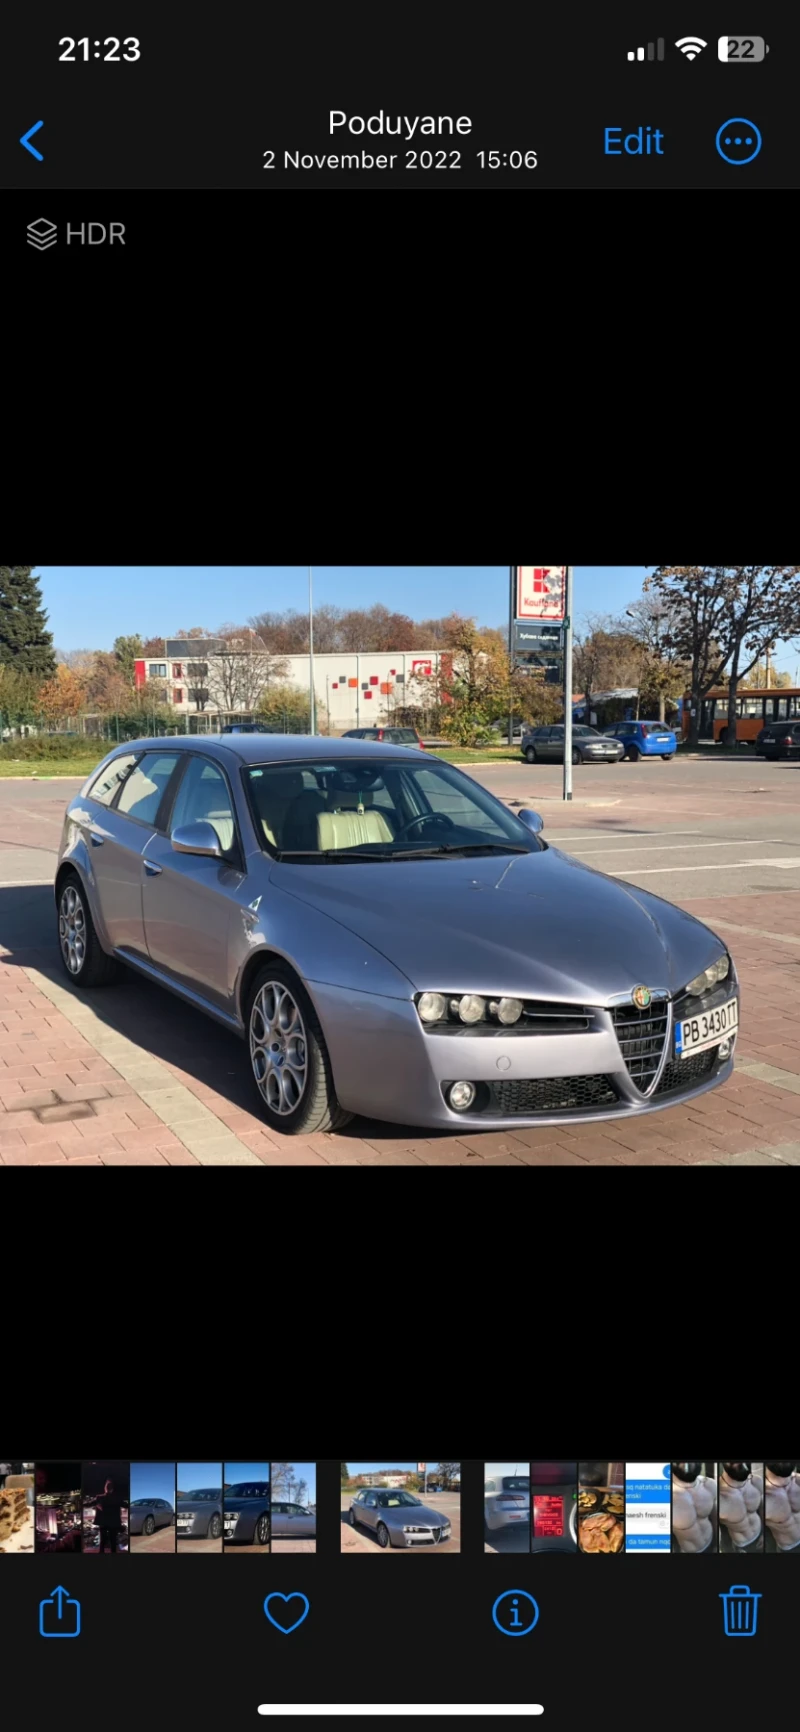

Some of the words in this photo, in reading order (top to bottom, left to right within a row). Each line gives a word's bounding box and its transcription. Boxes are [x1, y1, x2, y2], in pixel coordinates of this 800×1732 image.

[59, 37, 141, 62] 21:23
[727, 40, 755, 59] 22
[329, 110, 473, 140] Poduyane
[604, 126, 665, 155] Edit
[262, 151, 276, 169] 2
[285, 150, 398, 170] November
[406, 151, 462, 170] 2022
[477, 151, 538, 170] 15:06
[66, 222, 126, 245] HDR
[683, 1020, 700, 1046] PB
[702, 1008, 726, 1038] 3430
[727, 1001, 736, 1026] TT
